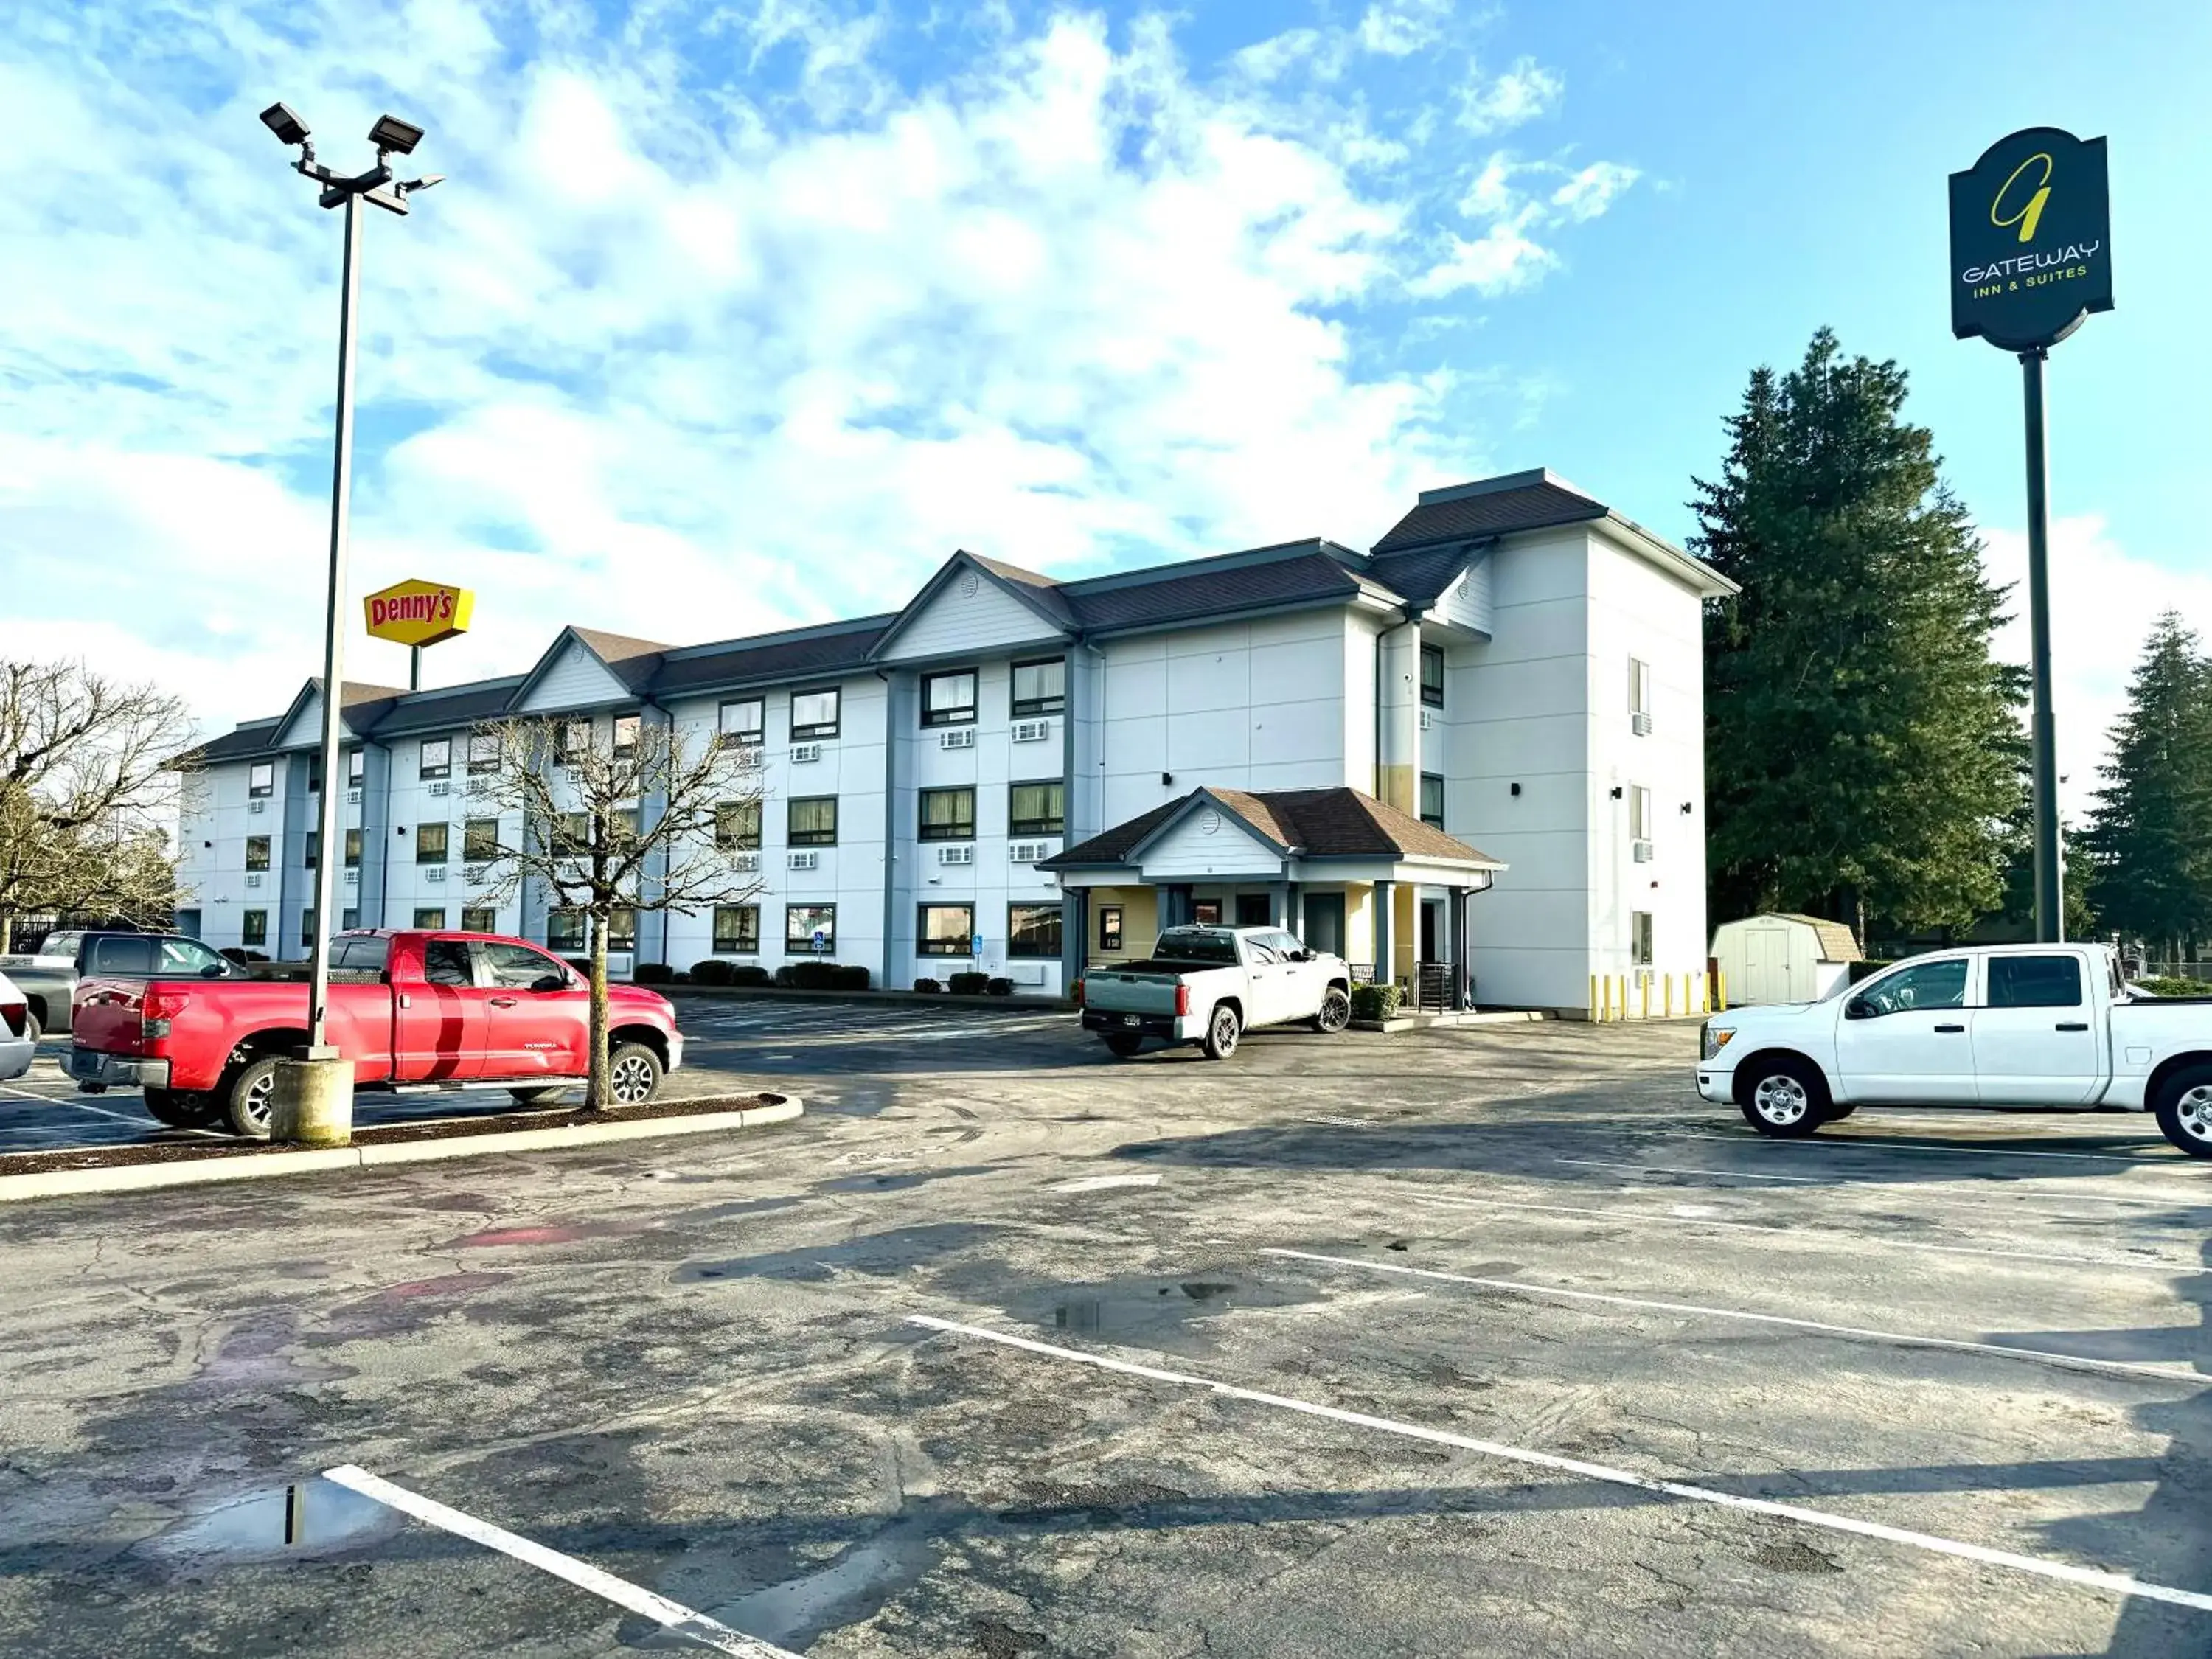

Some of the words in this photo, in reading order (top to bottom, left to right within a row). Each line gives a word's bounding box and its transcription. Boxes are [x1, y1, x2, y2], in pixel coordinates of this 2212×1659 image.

[1961, 240, 2100, 283] GATEWAY
[1973, 284, 2001, 299] INN
[2008, 281, 2019, 291] &
[2025, 265, 2087, 288] SUITES
[371, 589, 452, 627] Denny's
